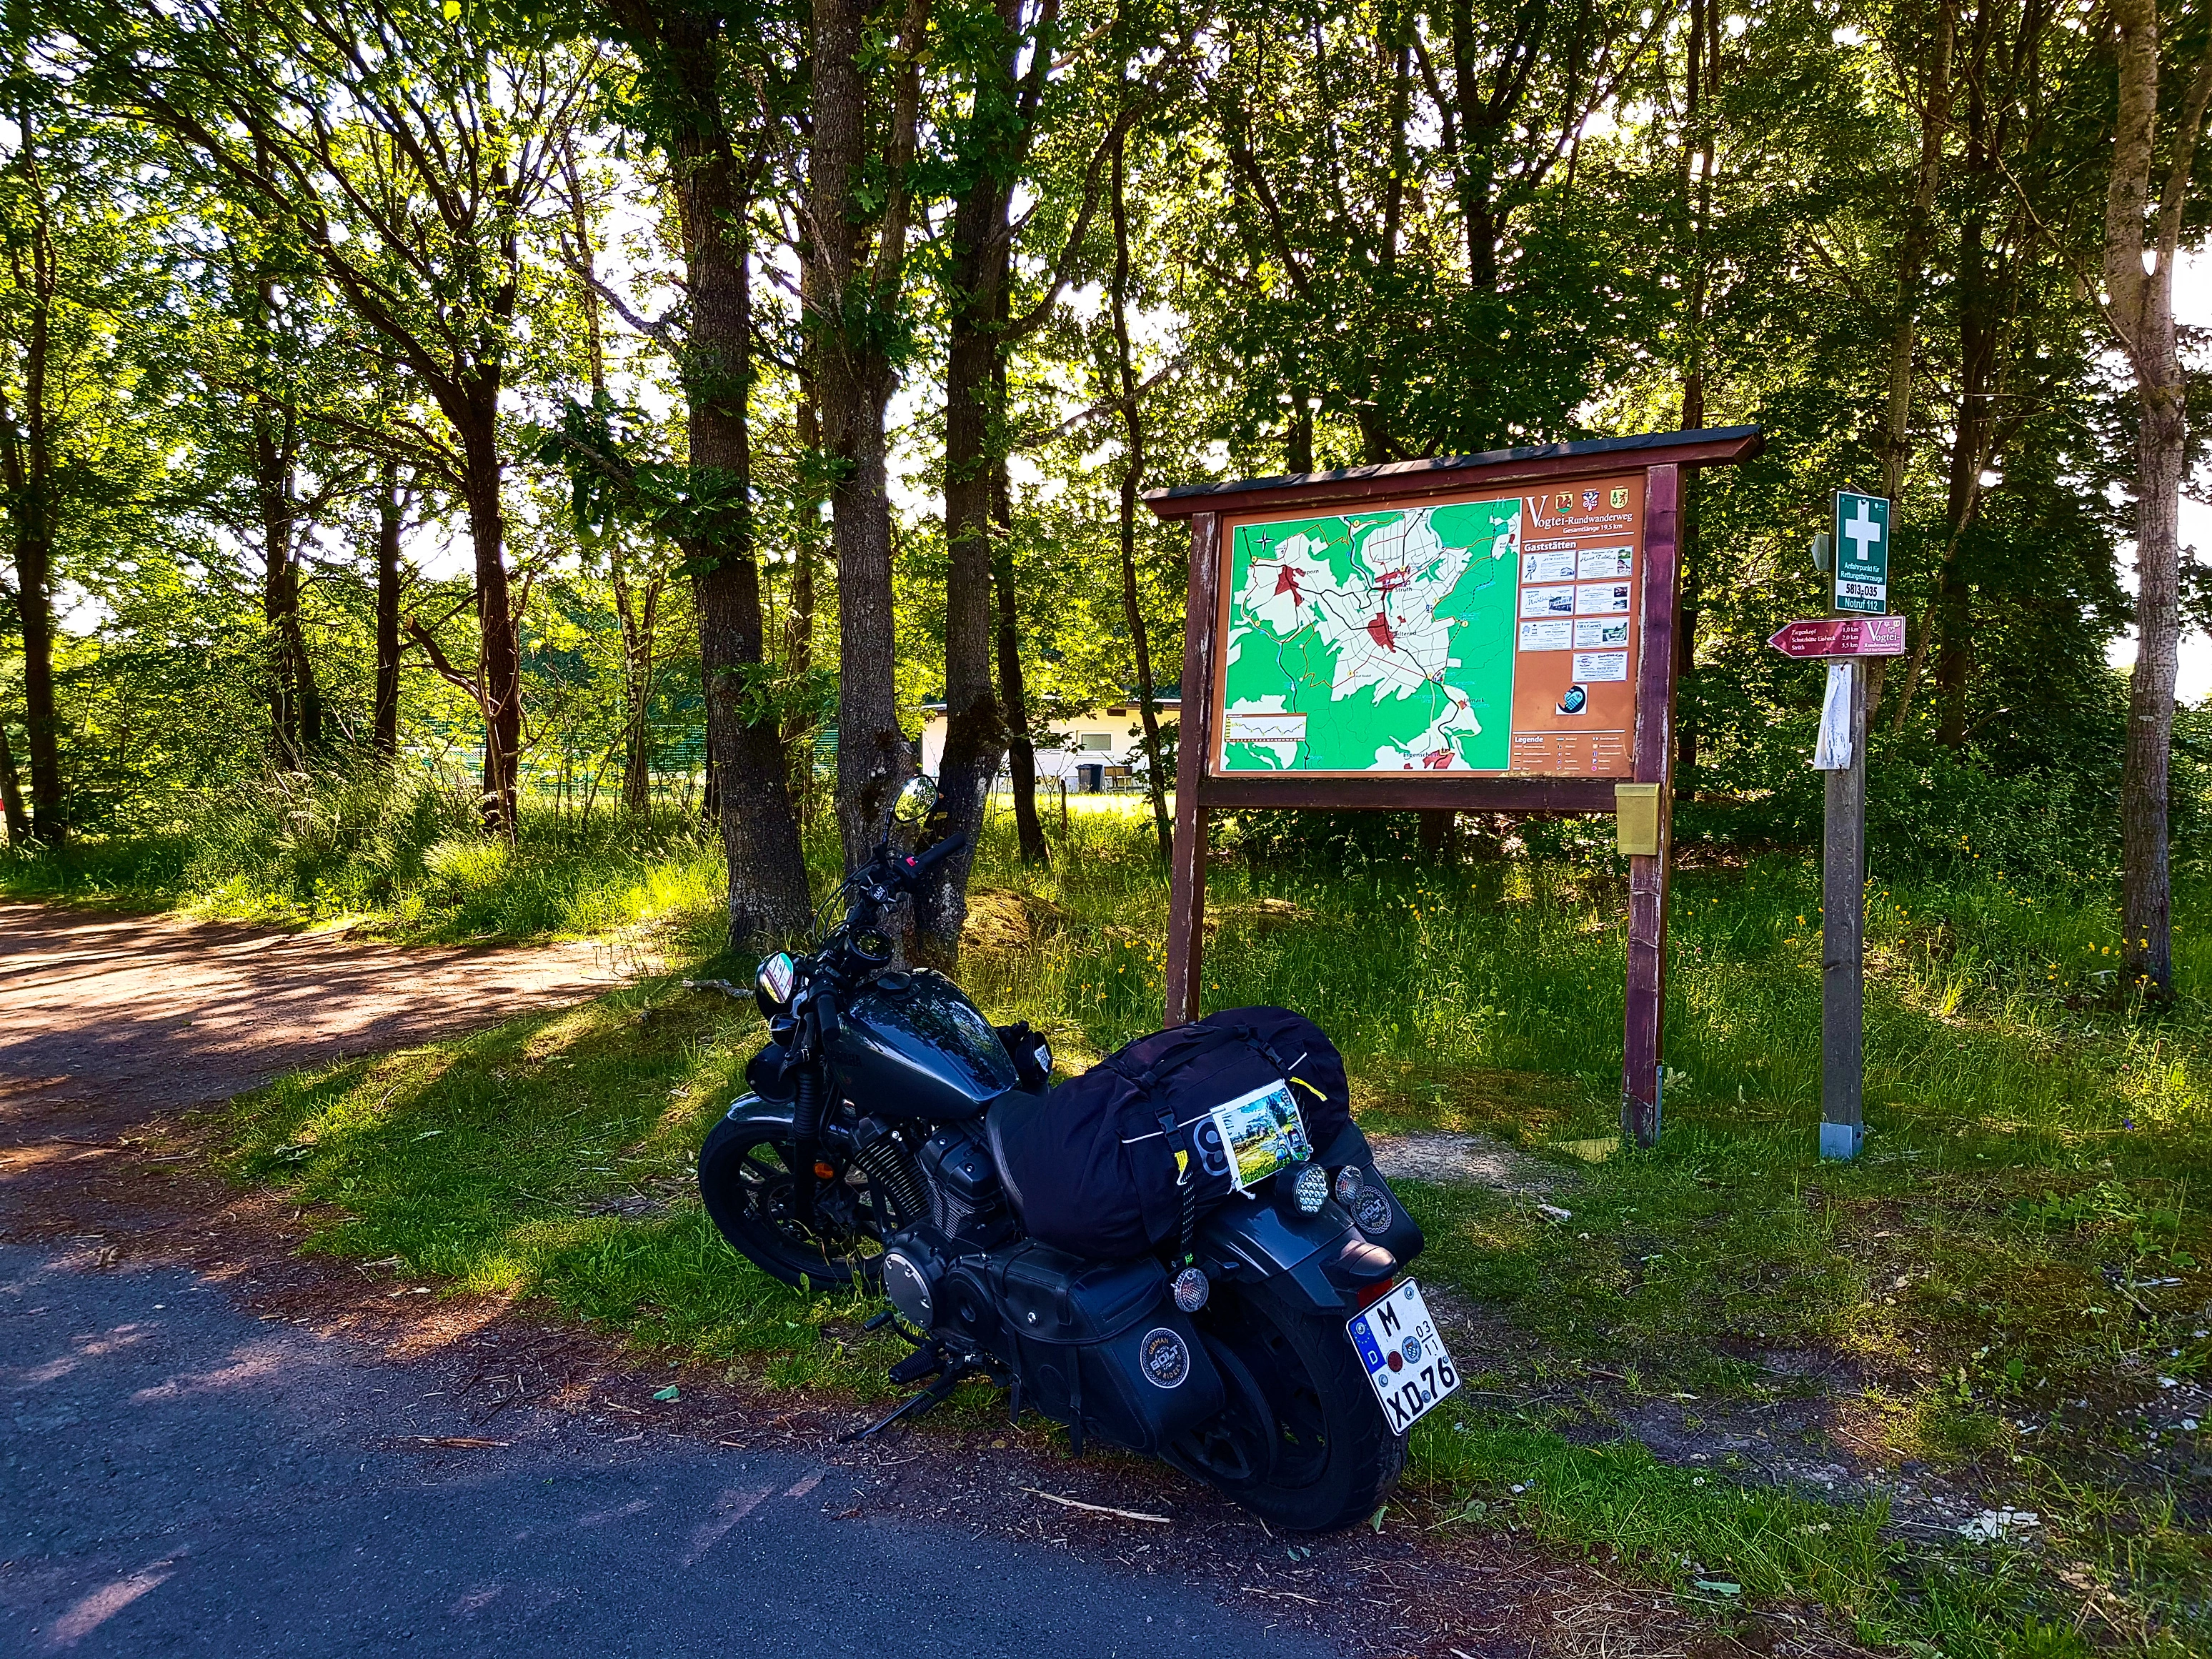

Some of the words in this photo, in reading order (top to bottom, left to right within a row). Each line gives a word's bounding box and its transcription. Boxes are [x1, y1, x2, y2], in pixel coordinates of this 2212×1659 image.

[1525, 494, 1633, 530] Vogtei-Rundwanderweg
[1563, 525, 1600, 534] Gesamtlänge
[1524, 541, 1576, 552] Gaststätten
[1844, 562, 1873, 572] Anfahrpunkt
[1840, 571, 1883, 583] Rettungsfahrzeuge
[1845, 583, 1878, 597] 5813-035
[1845, 597, 1865, 609] Notruf
[1866, 600, 1878, 611] 112
[1515, 735, 1544, 744] Legende
[873, 885, 886, 900] RAM
[1358, 1199, 1382, 1221] BOLT
[1376, 1300, 1401, 1337] M
[1415, 1320, 1431, 1338] 03
[1148, 1337, 1169, 1355] GERMAN
[1150, 1344, 1178, 1371] BOLT
[1367, 1350, 1378, 1365] D
[1162, 1363, 1181, 1380] RIDERS
